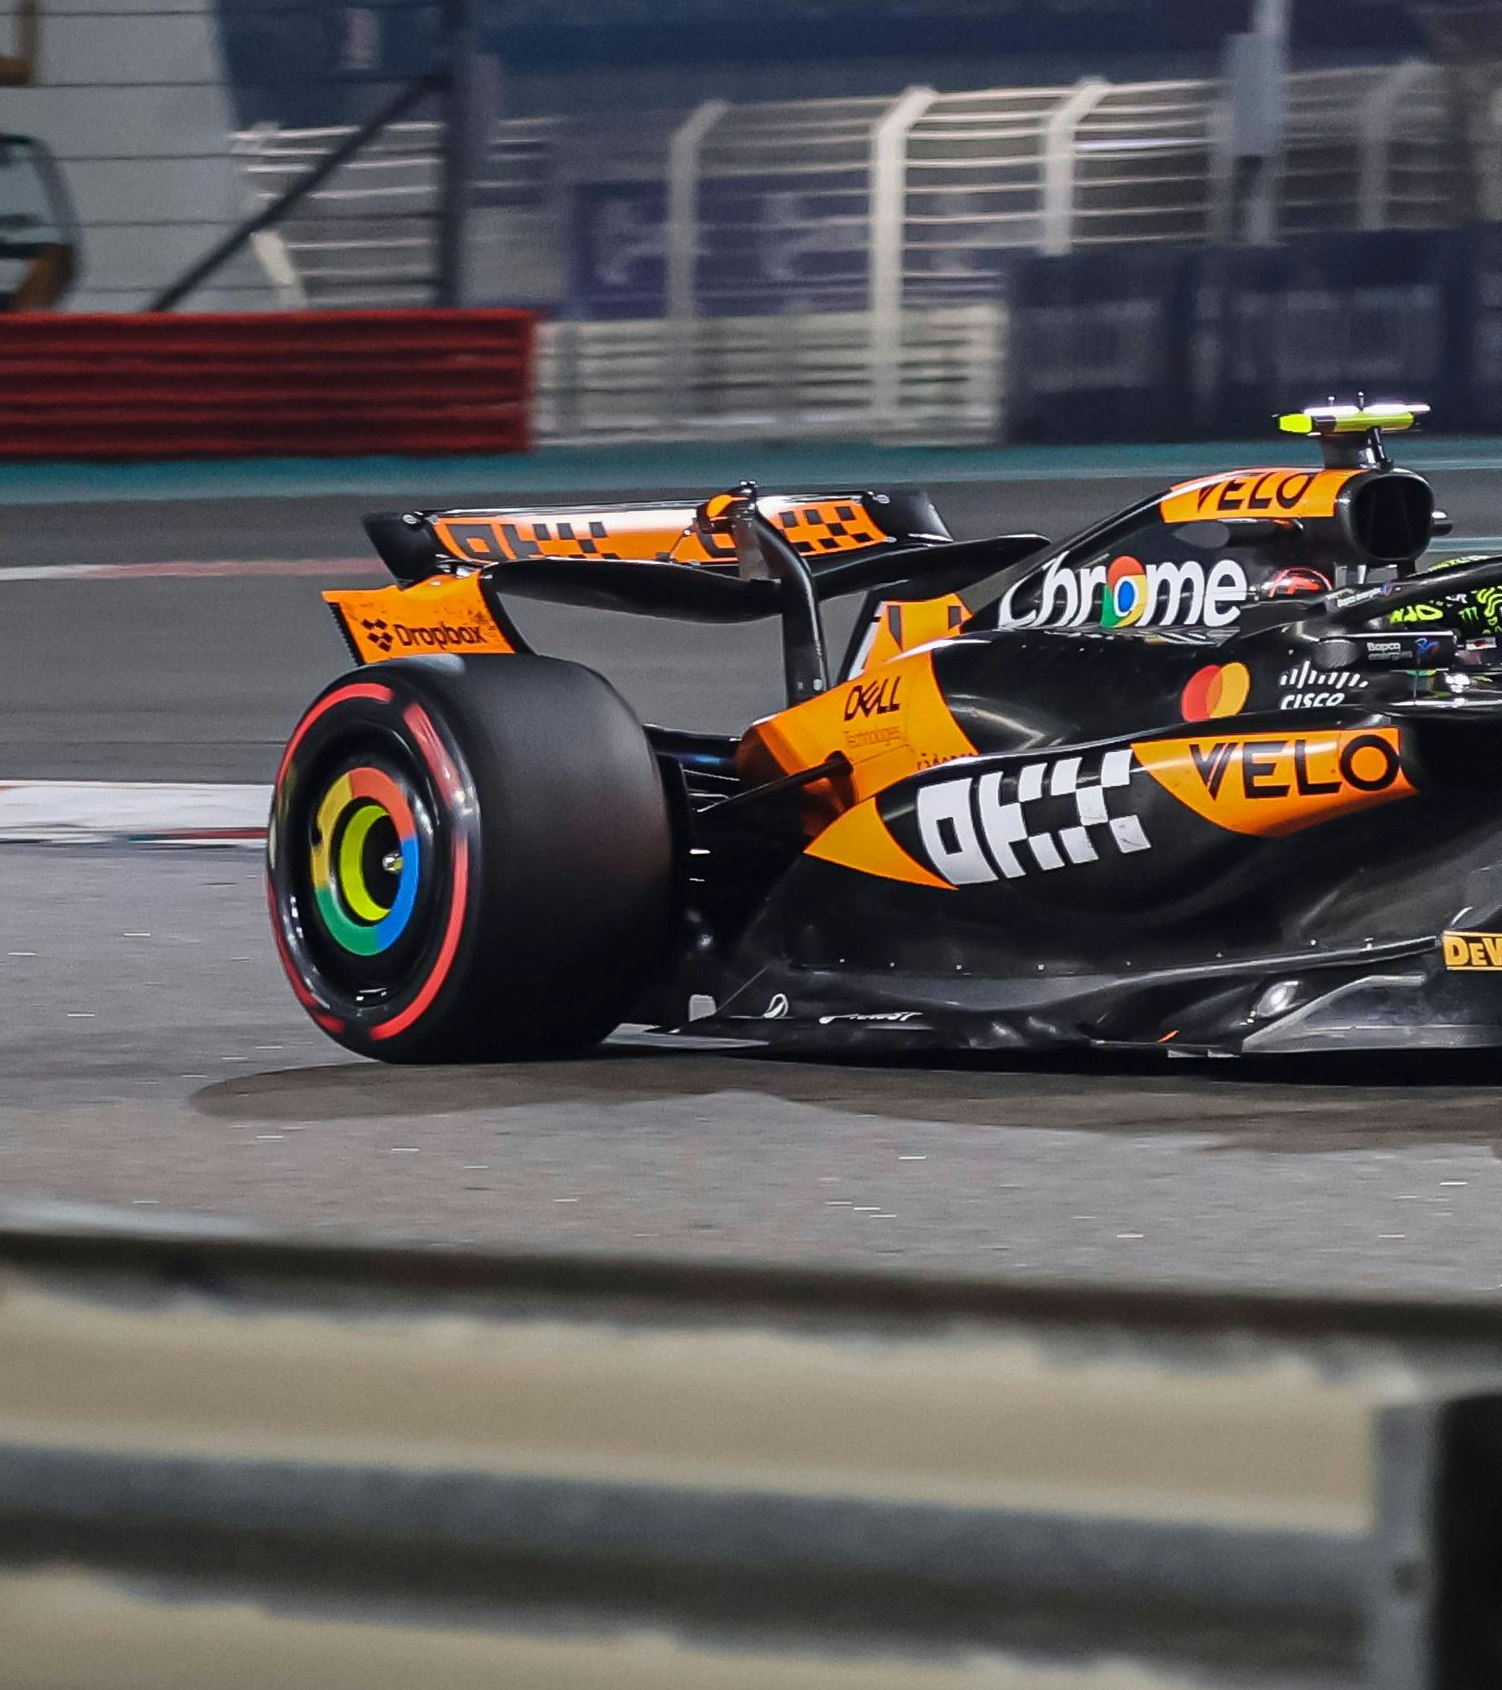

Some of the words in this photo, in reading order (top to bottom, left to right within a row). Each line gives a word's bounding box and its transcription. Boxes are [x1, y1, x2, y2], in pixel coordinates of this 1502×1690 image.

[1197, 471, 1318, 512] VELO
[998, 551, 1247, 628] chrome
[393, 621, 487, 650] Dropbox
[844, 676, 901, 721] DELL
[1189, 734, 1400, 799] VELO
[917, 749, 1152, 885] OKX
